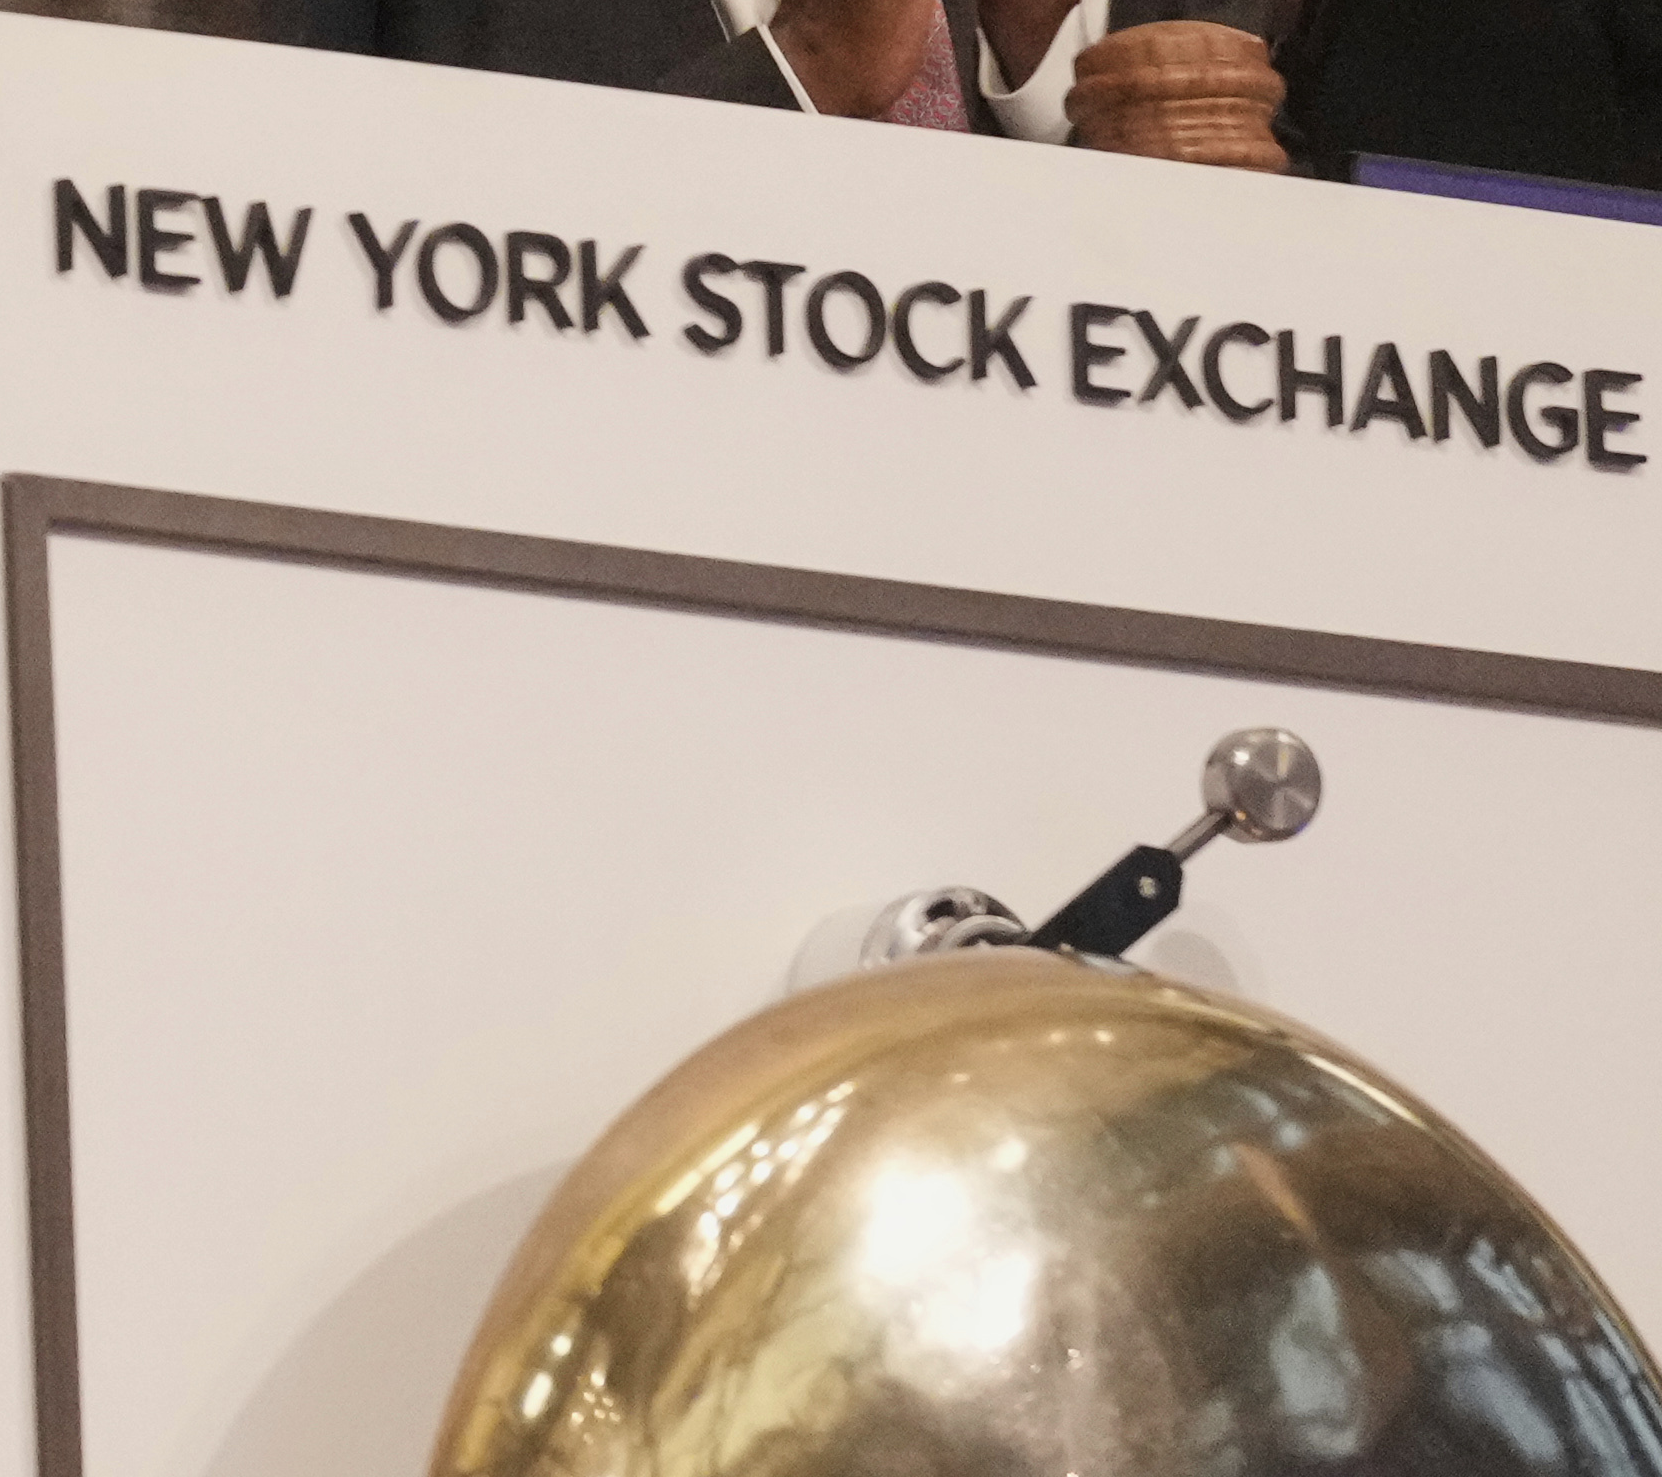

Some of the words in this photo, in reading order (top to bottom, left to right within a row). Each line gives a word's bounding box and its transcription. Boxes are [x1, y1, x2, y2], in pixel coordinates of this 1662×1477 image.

[53, 178, 313, 300] NEW
[346, 211, 652, 341] YORK
[681, 252, 1038, 392] STOCK
[1068, 301, 1649, 475] EXCHANGE
